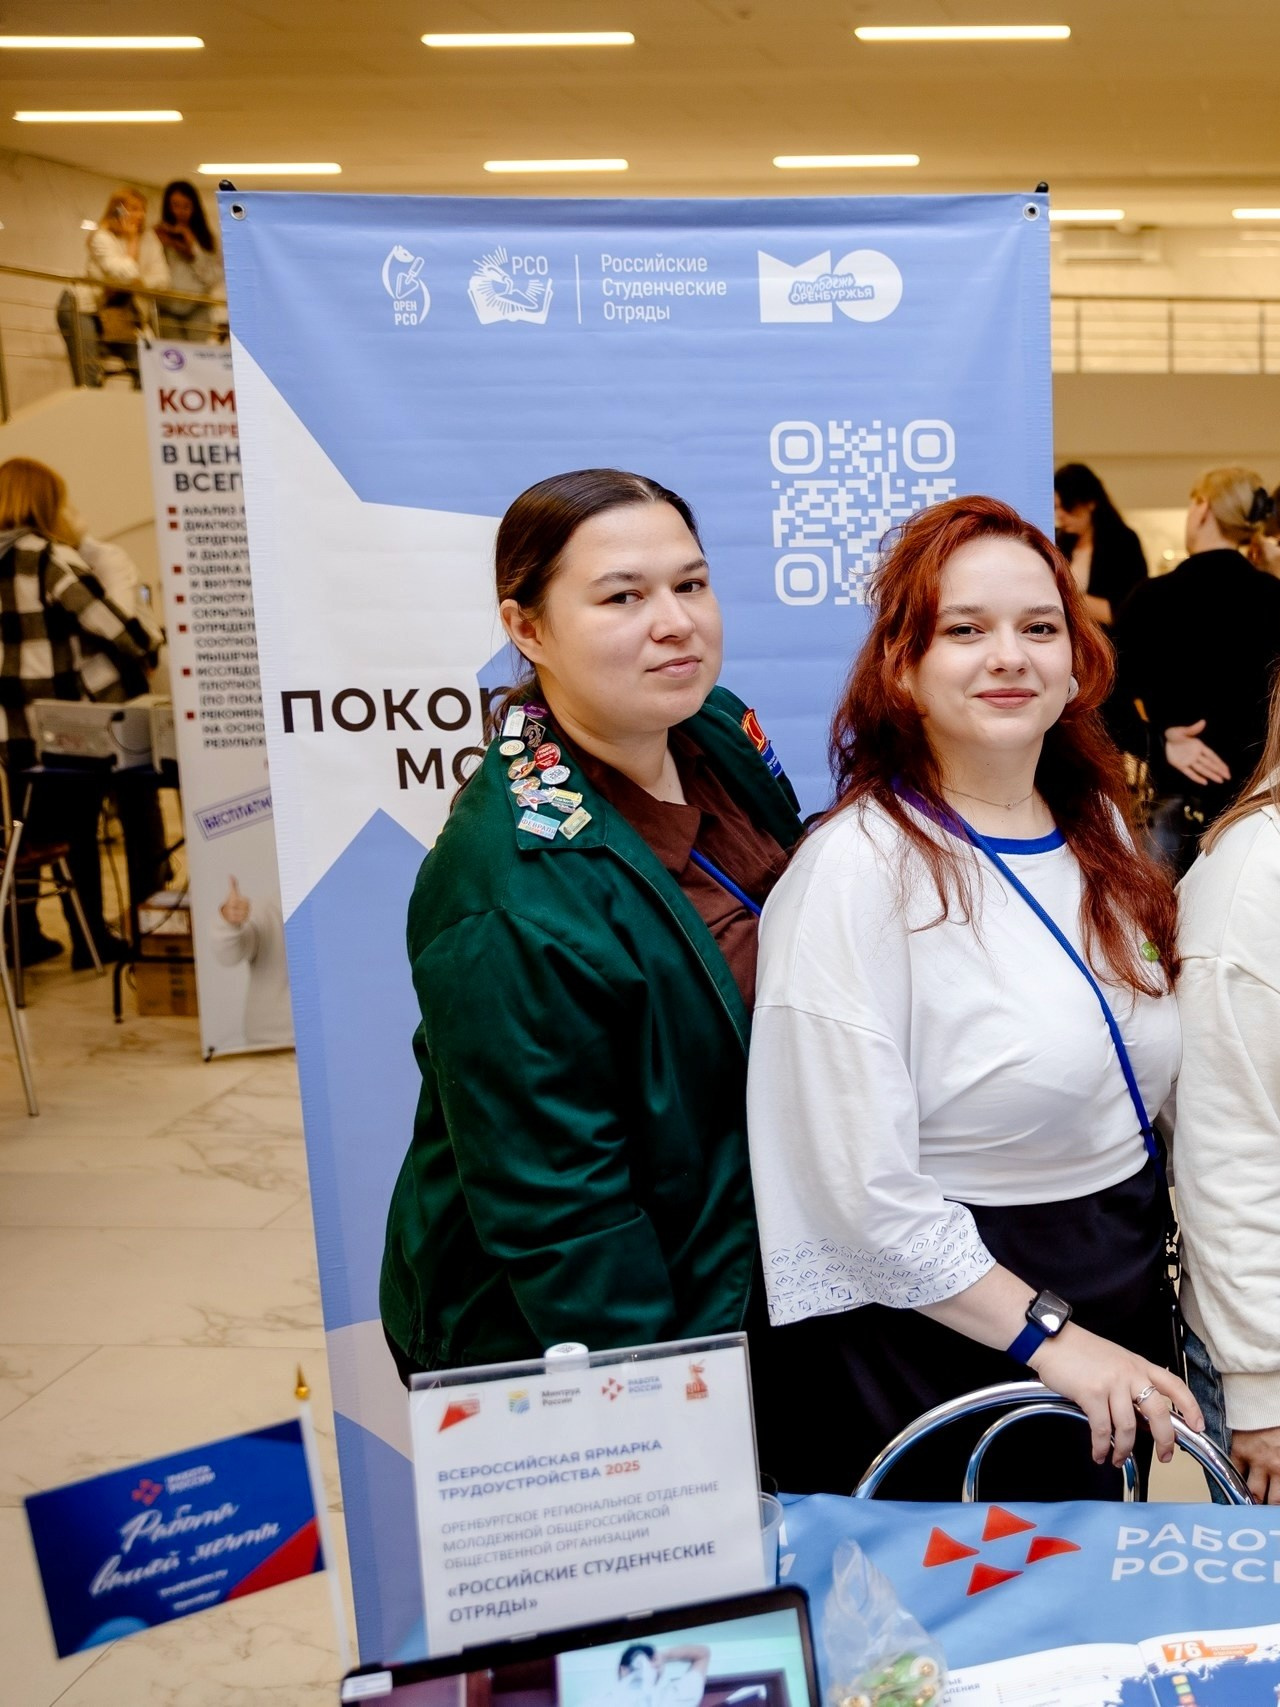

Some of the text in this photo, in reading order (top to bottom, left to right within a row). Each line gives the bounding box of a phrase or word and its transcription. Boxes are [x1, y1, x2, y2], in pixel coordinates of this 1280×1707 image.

[511, 256, 549, 275] РСО
[600, 253, 708, 273] Российские
[602, 278, 727, 298] Студенческие
[790, 287, 874, 303] ОРЕНБУРЖЬЯ
[393, 300, 417, 311] ОРЕН
[603, 302, 670, 323] Отряды
[394, 313, 418, 326] РСО
[158, 388, 237, 413] КОМ
[162, 445, 241, 467] В ЦЕН
[437, 1439, 663, 1482] ВСЕРОССИЙСКАЯ ЯРМАРКА
[438, 1460, 641, 1501] ТРУДОУСТРОЙСТВА 2025
[440, 1480, 720, 1536] ОРЕНБУРГСКОЕ РЕГИОНАЛЬНОЕ ОТДЕЛЕНИЕ
[443, 1505, 671, 1553] МОЛОДЕЖНОЙ ОБЩЕРОССИЙСКОЙ
[444, 1527, 650, 1570] ОБЩЕСТВЕННОЙ ОРГАНИЗАЦИИ
[448, 1541, 716, 1598] «РОССИЙСКИЕ СТУДЕНЧЕСКИЕ
[449, 1597, 538, 1623] ОТРЯДЫ»
[1167, 1641, 1202, 1660] 76
